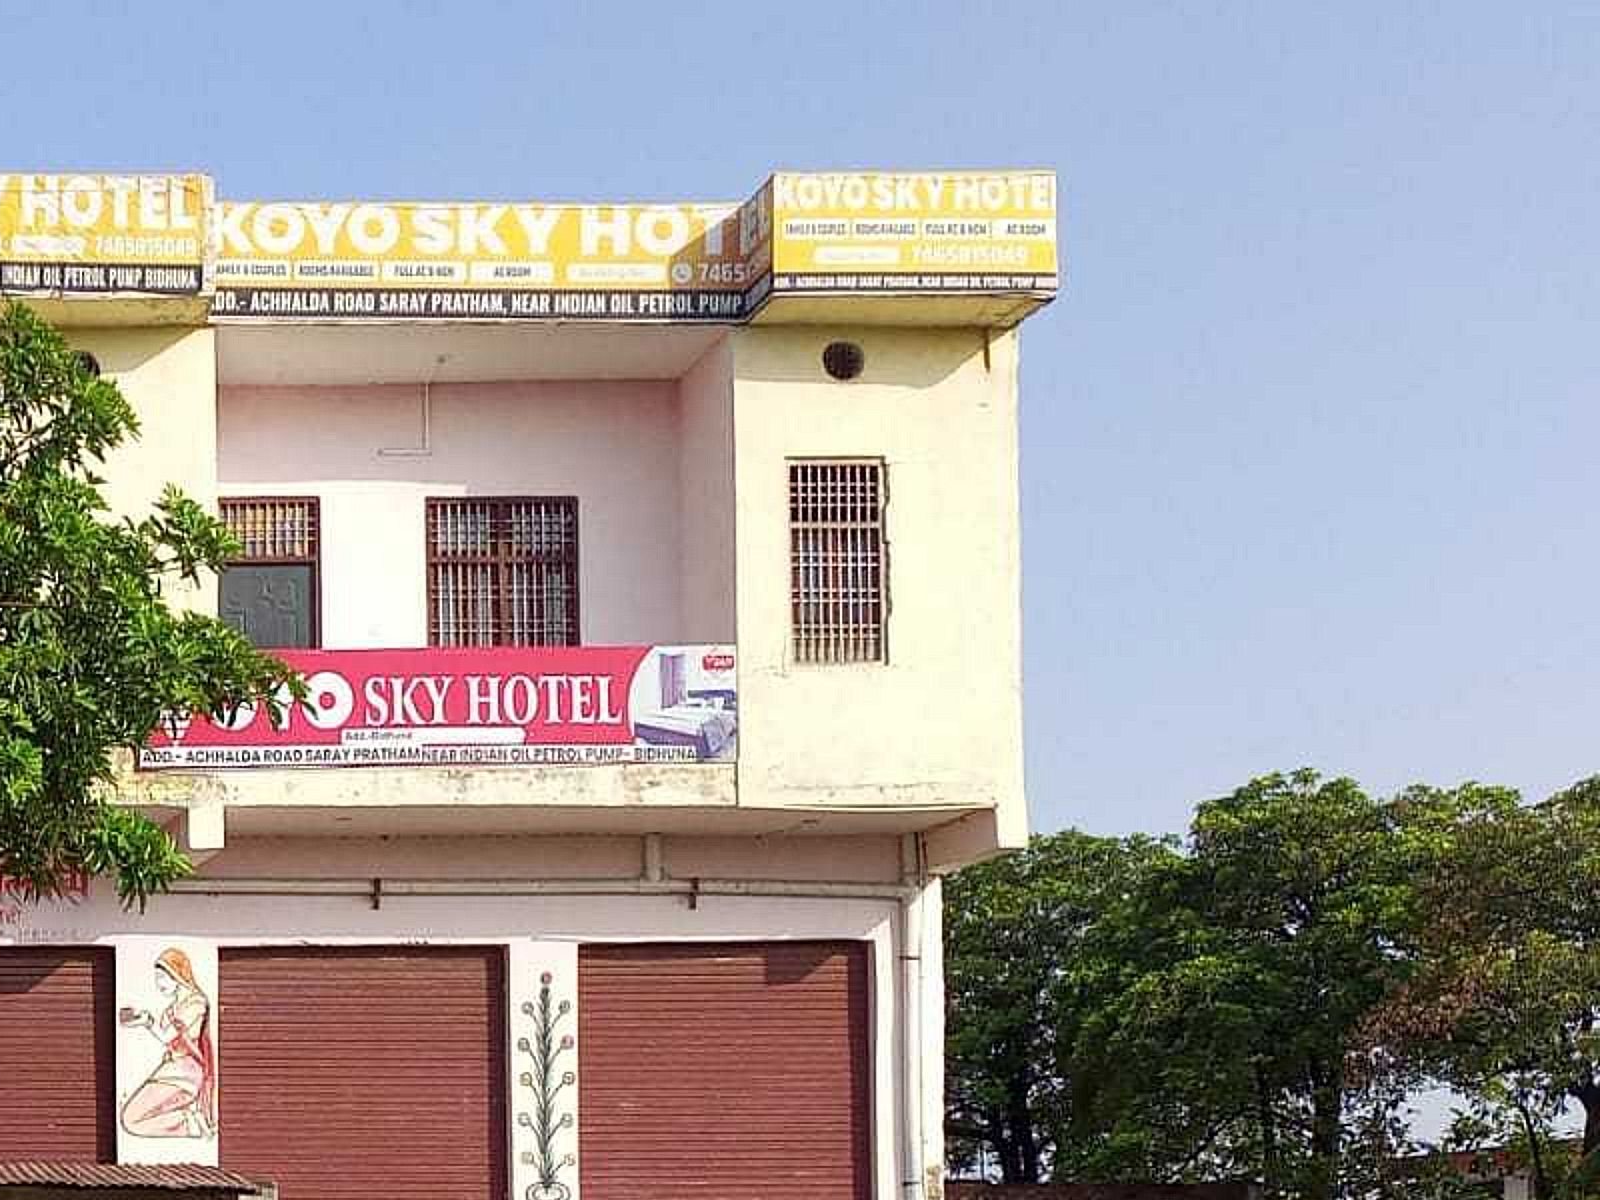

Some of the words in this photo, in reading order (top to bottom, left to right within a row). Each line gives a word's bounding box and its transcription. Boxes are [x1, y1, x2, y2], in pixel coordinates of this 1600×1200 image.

[24, 176, 193, 229] HOTEL
[874, 175, 946, 211] SKY
[212, 203, 401, 255] KOYO
[410, 204, 562, 257] SKY
[43, 267, 62, 287] OIL
[109, 268, 142, 288] PUMP
[212, 292, 246, 312] DD.-
[250, 293, 329, 312] ACHHALDA
[333, 293, 375, 312] ROAD
[379, 293, 429, 312] SARAY
[431, 293, 508, 315] PRATHAM,
[511, 293, 550, 313] NEAR
[554, 294, 608, 313] INDIAN
[611, 294, 635, 313] OIL
[639, 294, 694, 313] PETROL
[700, 294, 743, 314] PUMP
[364, 674, 454, 727] SKY
[465, 674, 623, 727] HOTEL
[185, 749, 261, 764] ACHHALDA
[263, 748, 303, 763] ROAD
[305, 748, 350, 762] SARAY
[353, 746, 421, 761] PRATHAM
[460, 747, 508, 762] INDIAN
[510, 747, 533, 761] OIL
[533, 747, 583, 762] PETROL
[634, 747, 697, 761] BIDHUNA
